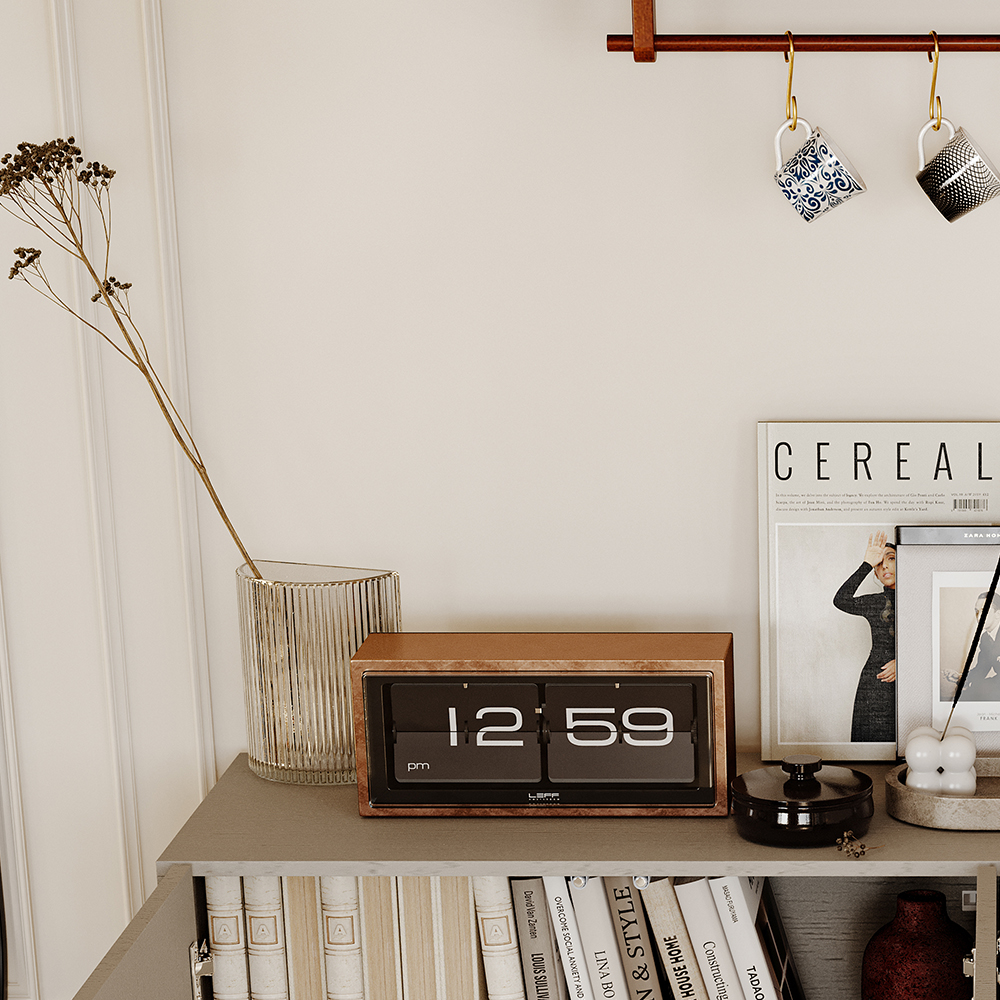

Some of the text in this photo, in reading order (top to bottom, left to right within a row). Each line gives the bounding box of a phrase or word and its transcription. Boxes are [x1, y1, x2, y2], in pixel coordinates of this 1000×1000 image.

[774, 441, 993, 481] CEREAL
[448, 707, 674, 747] 12 59
[407, 762, 430, 772] pm
[524, 890, 538, 939] David Van Zanten
[613, 886, 645, 959] STYLE
[531, 953, 546, 974] LOUIS
[554, 896, 569, 931] OVERCOME
[563, 931, 573, 956] SOCIAL
[569, 956, 581, 983] ANXIETY
[575, 983, 584, 999] AND
[594, 950, 611, 979] LINA
[663, 935, 684, 964] HOME
[632, 963, 649, 980] &
[673, 965, 696, 998] HOUSE
[703, 941, 729, 1000] Constructing
[746, 965, 766, 1000] TADAO
[602, 981, 615, 998] BO
